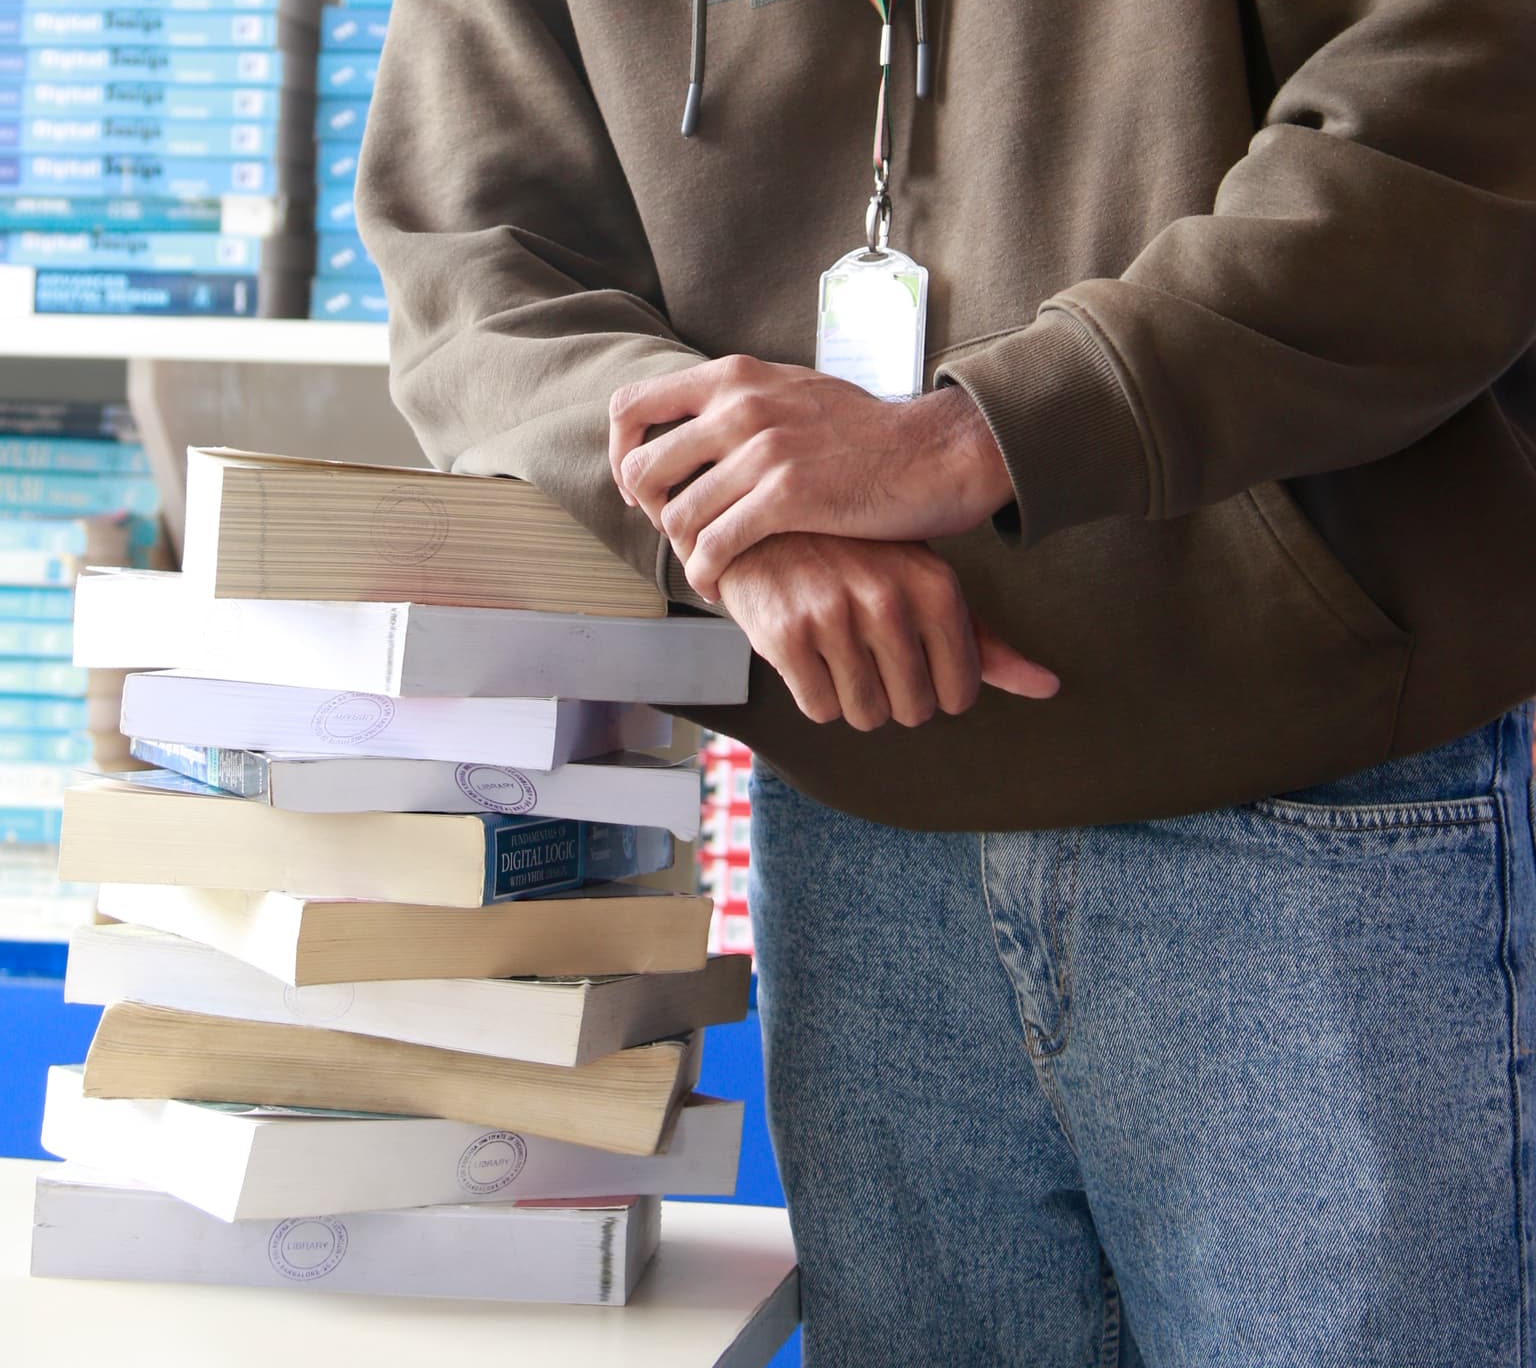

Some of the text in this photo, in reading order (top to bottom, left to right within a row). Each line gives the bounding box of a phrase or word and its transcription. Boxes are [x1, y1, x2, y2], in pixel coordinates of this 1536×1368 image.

[501, 848, 543, 873] DIGITAL
[545, 839, 576, 862] LOGIC
[474, 1158, 510, 1169] LIBRARY
[287, 1241, 329, 1251] LIBRARY
